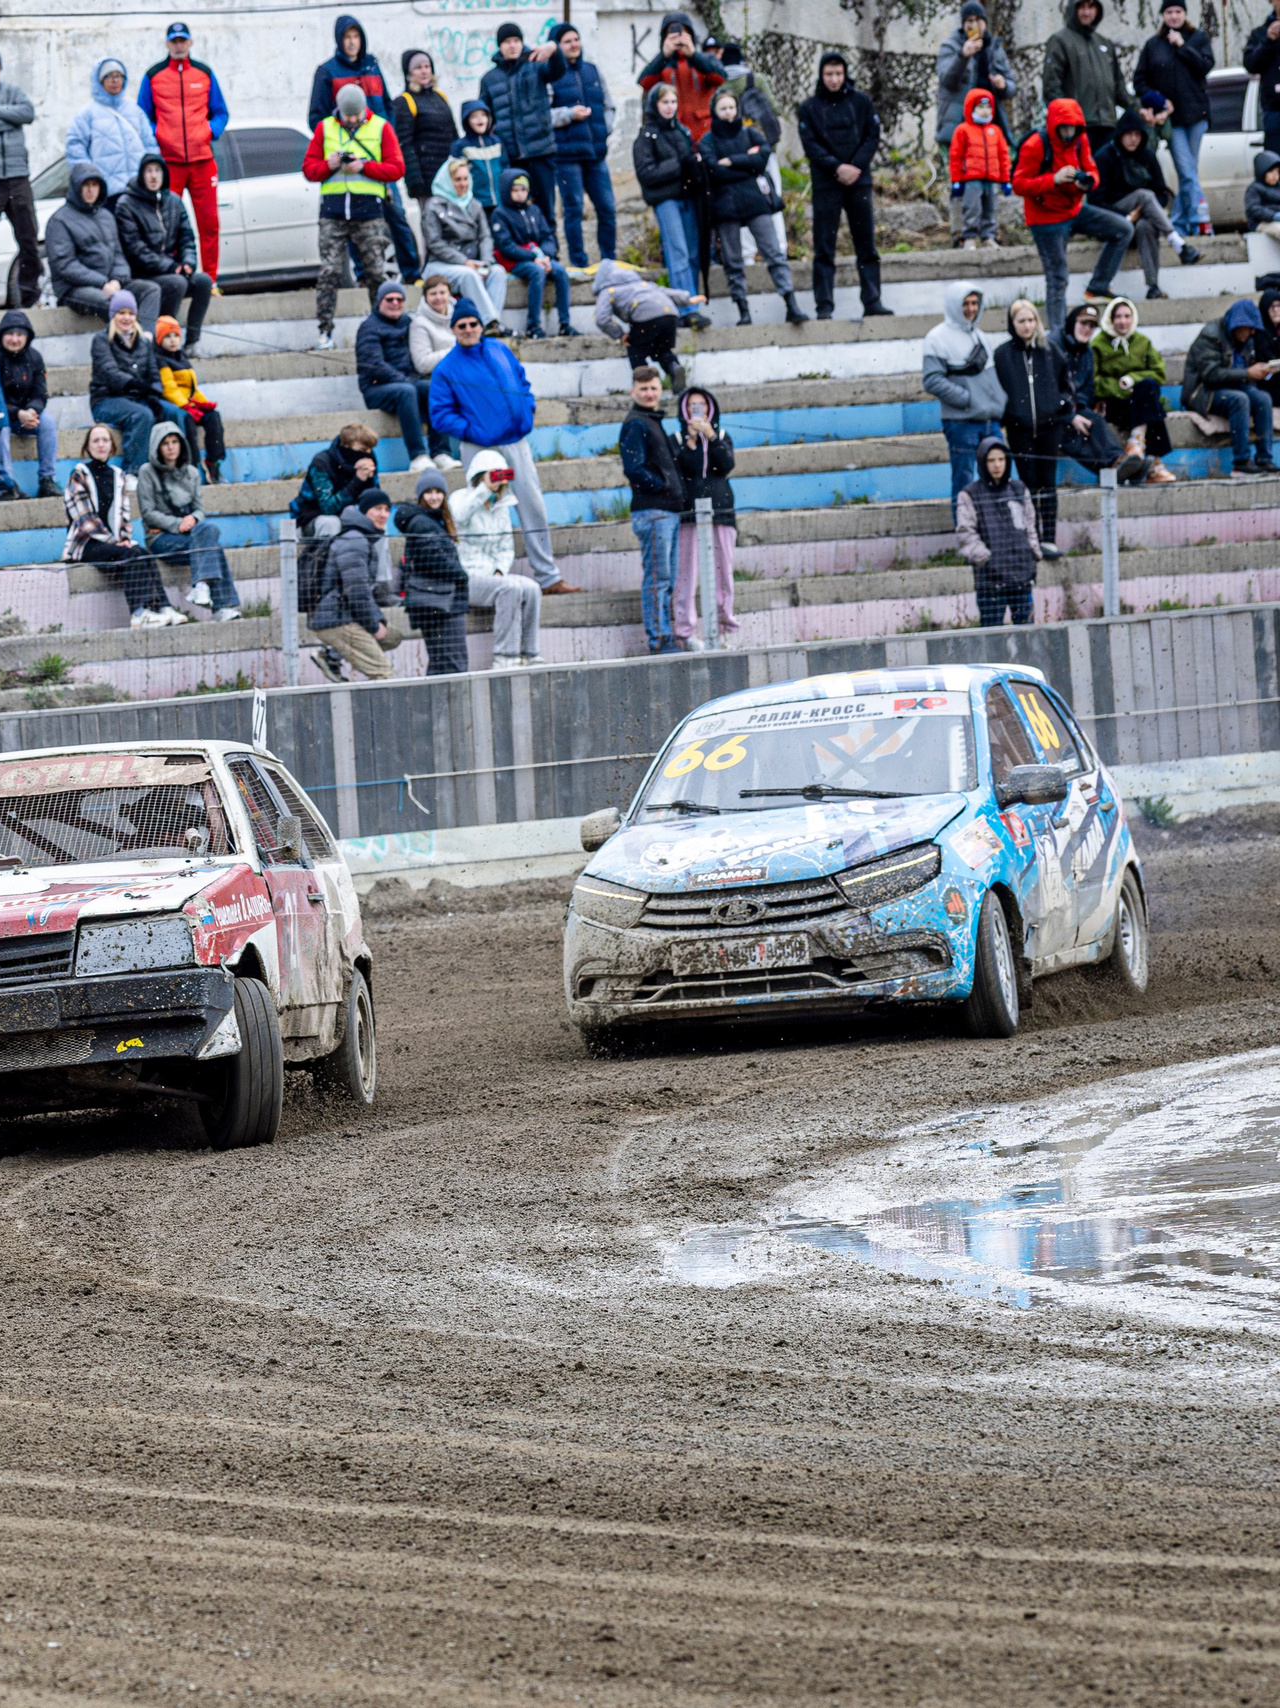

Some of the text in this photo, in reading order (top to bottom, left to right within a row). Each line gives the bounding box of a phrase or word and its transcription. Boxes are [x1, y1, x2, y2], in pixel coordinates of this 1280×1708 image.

[253, 696, 266, 743] 27
[747, 703, 866, 724] РАЛЛИ-КРОСС
[1018, 693, 1060, 750] 66
[663, 735, 750, 778] 66
[697, 869, 761, 884] KRAMAR
